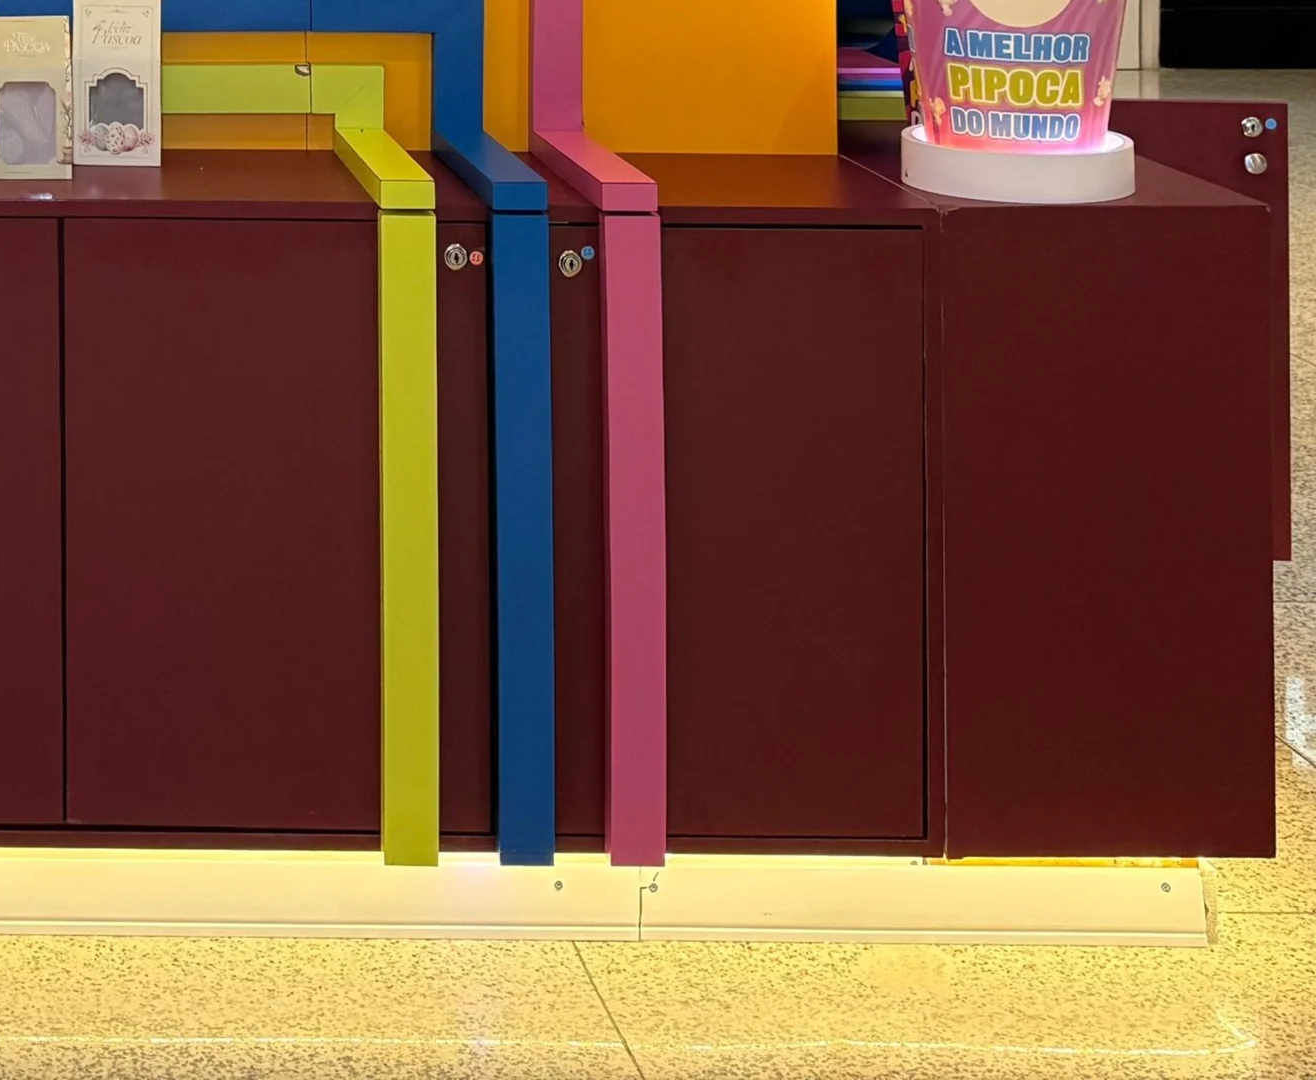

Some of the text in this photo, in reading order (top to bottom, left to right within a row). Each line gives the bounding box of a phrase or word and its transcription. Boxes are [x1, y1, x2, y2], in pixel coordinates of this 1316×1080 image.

[944, 28, 1091, 62] A MELHOR
[947, 62, 1083, 107] PIPOCA
[951, 106, 985, 136] DO
[988, 110, 1081, 142] MUNDO
